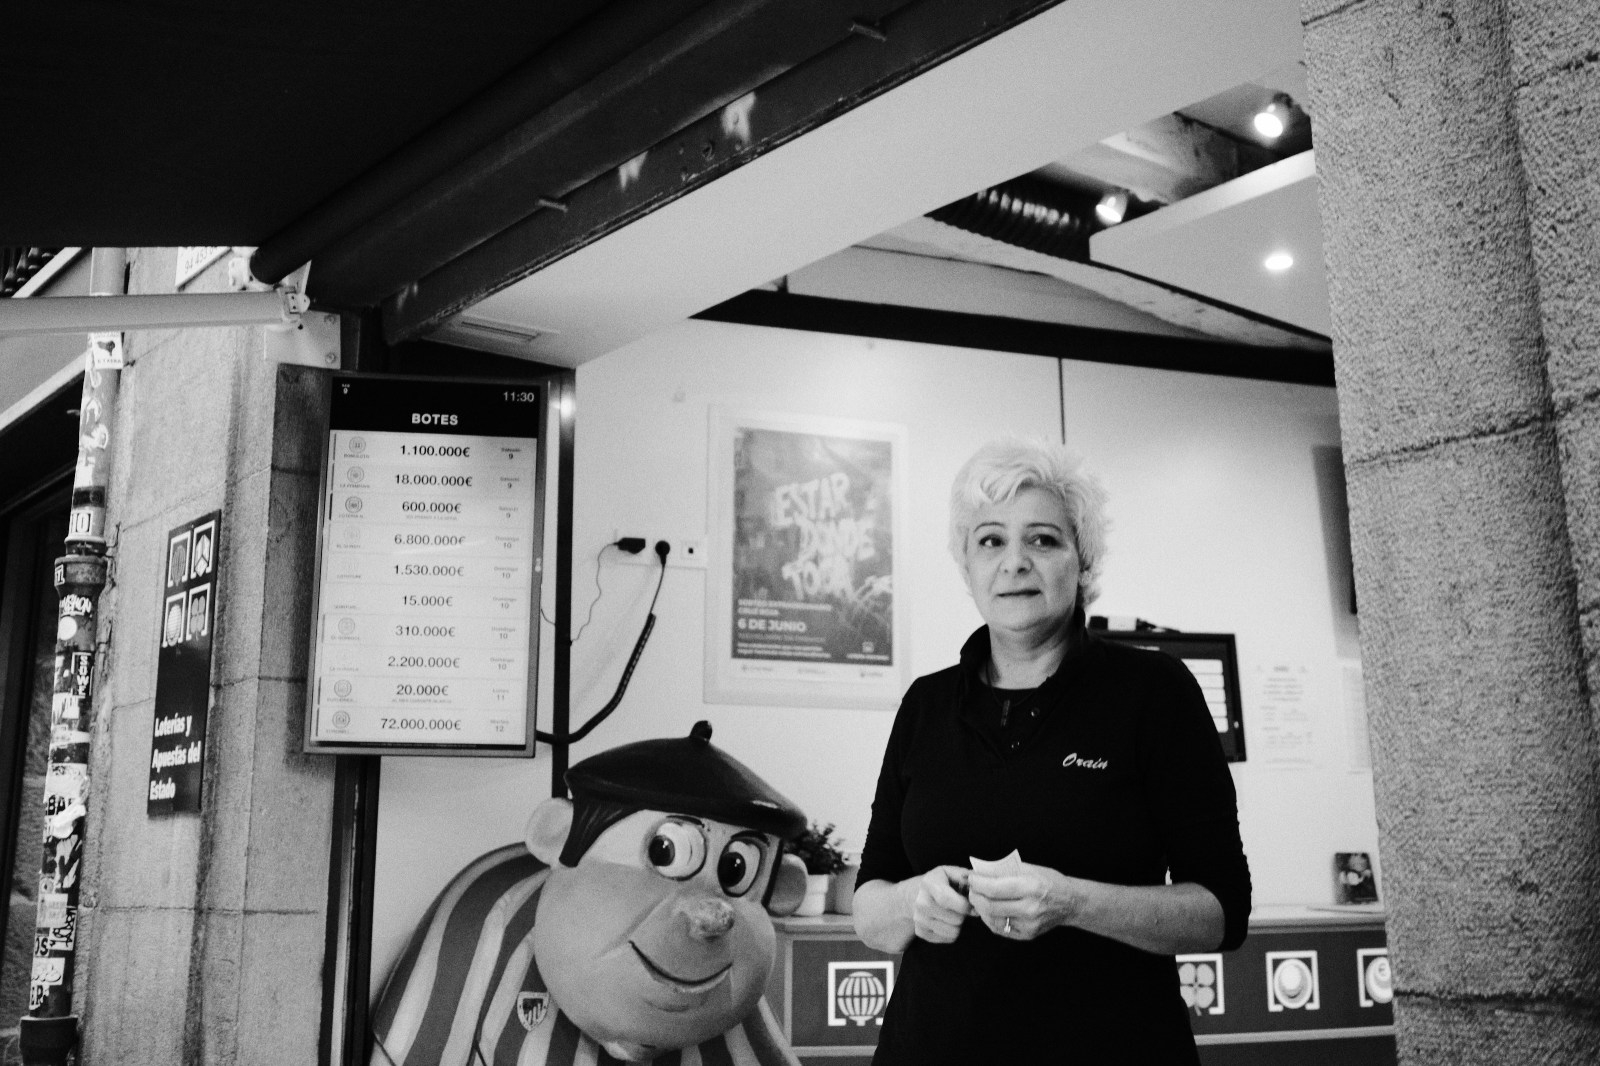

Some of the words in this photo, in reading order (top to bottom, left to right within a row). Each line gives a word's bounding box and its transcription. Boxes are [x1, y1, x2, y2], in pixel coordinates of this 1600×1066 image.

[503, 391, 535, 402] 11:30
[411, 413, 459, 426] BOTES
[400, 445, 470, 458] 1.100.000€
[395, 474, 473, 487] 18.000.000€
[770, 472, 851, 527] ESTAR
[402, 501, 462, 514] 600.000€
[394, 533, 466, 546] 6.800.000€
[394, 564, 465, 577] 1.530.000€
[402, 595, 454, 607] 15.000€
[395, 625, 456, 638] 310.000€
[737, 618, 747, 630] 6
[748, 618, 767, 631] DE
[767, 619, 807, 633] JUNIO
[387, 656, 460, 669] 2.200.000€
[396, 684, 449, 697] 20.000€
[154, 712, 186, 737] Loterías
[185, 715, 193, 737] y
[380, 718, 461, 731] 72.000.000€
[151, 745, 187, 773] Apuestas
[187, 740, 202, 764] del
[1062, 752, 1108, 770] Orain
[149, 777, 176, 800] Estado
